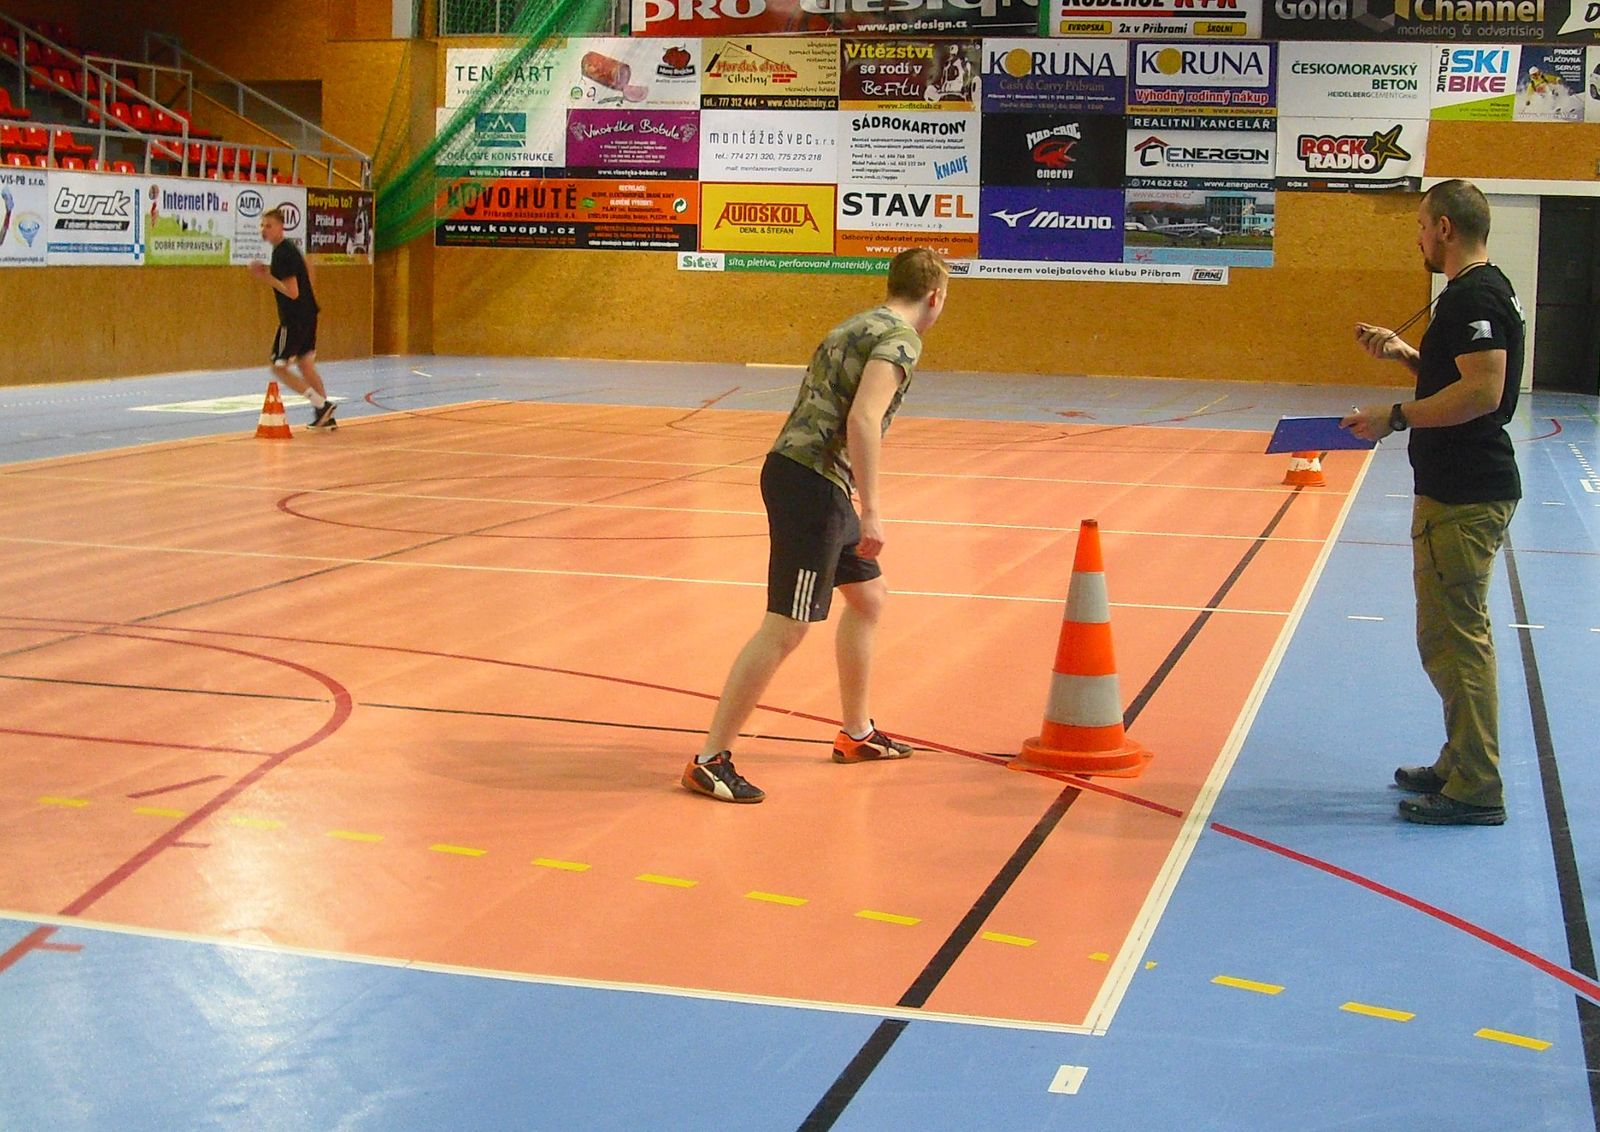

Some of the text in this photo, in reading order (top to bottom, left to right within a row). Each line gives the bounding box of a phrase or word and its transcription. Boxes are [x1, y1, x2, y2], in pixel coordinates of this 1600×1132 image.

[1275, 0, 1545, 22] Gold Channel
[857, 19, 968, 33] www.pro-design.cz
[1119, 24, 1131, 33] 2x
[1397, 25, 1544, 39] marketing & advertising
[845, 43, 936, 59] Vítězství
[860, 62, 923, 74] se rodí v
[989, 49, 1116, 78] KORUNA
[1141, 48, 1264, 76] KORUNA
[1291, 60, 1418, 76] ČESKOMORAVSKÝ
[1450, 49, 1511, 74] SKI
[1372, 79, 1418, 90] BETON
[1447, 75, 1507, 93] BIKE
[1135, 89, 1184, 104] Výhodný
[1232, 90, 1269, 105] nákup
[851, 114, 967, 136] SÁDROKARTONY
[1134, 117, 1270, 129] REALITNÍ KANCELÁŘ
[1166, 147, 1270, 163] ENERGON
[1300, 137, 1367, 158] ROCK
[491, 152, 554, 163] KONSTRUKCE
[731, 152, 744, 160] 774
[745, 152, 759, 160] 271
[777, 153, 792, 161] 775
[792, 153, 807, 161] 275
[807, 153, 822, 161] 218
[1308, 153, 1377, 170] RADIO
[1141, 178, 1270, 192] 774 622 622 www.energon.cz
[163, 189, 205, 212] Internet
[239, 196, 262, 210] AUTA
[842, 192, 974, 219] STAVEL
[1028, 211, 1112, 230] MIZUNO
[444, 224, 577, 236] www.kovopb.cz
[979, 264, 1182, 279] Partnerem volejbalového klubu Příbram
